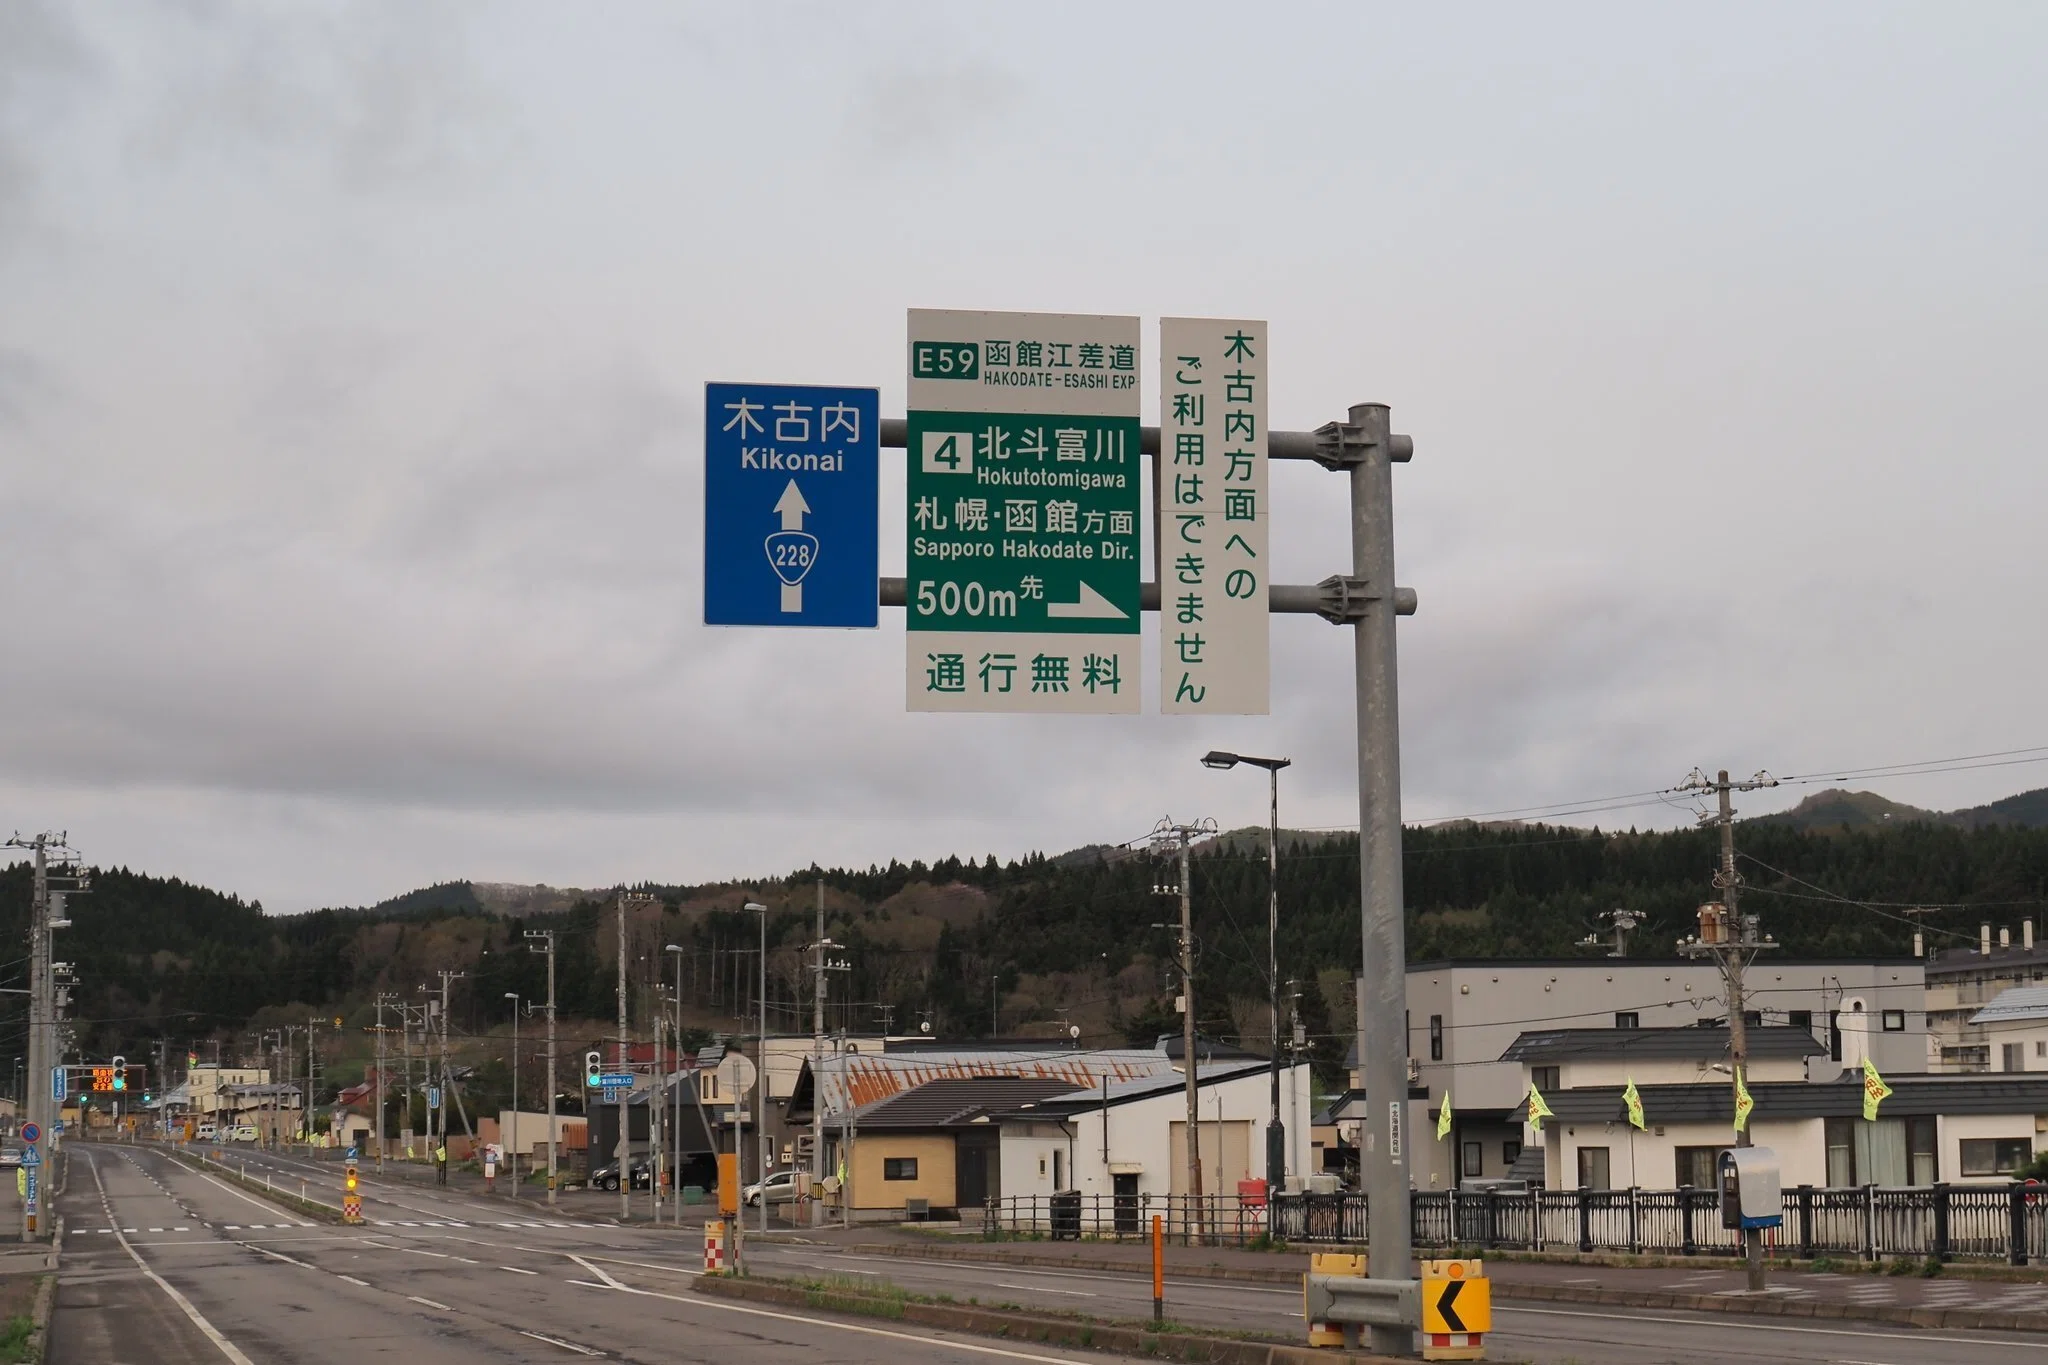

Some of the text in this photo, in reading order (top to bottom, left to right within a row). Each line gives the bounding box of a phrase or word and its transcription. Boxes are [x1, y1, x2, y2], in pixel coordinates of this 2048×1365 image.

[918, 348, 975, 373] E59
[984, 339, 1136, 371] 函館江差道
[1112, 374, 1136, 390] EXP
[722, 396, 860, 443] 木古内
[741, 446, 844, 472] Kikonai
[934, 435, 961, 470] 4
[978, 425, 1125, 464] 北斗富川
[977, 466, 1126, 491] Hokutotomigawa
[1223, 329, 1257, 600] 木古内方面への
[1172, 355, 1206, 704] ご利用はできません
[776, 544, 810, 567] 228
[914, 537, 1135, 561] Sapporo Hakodate Dir.
[926, 652, 1122, 694] 通行無料
